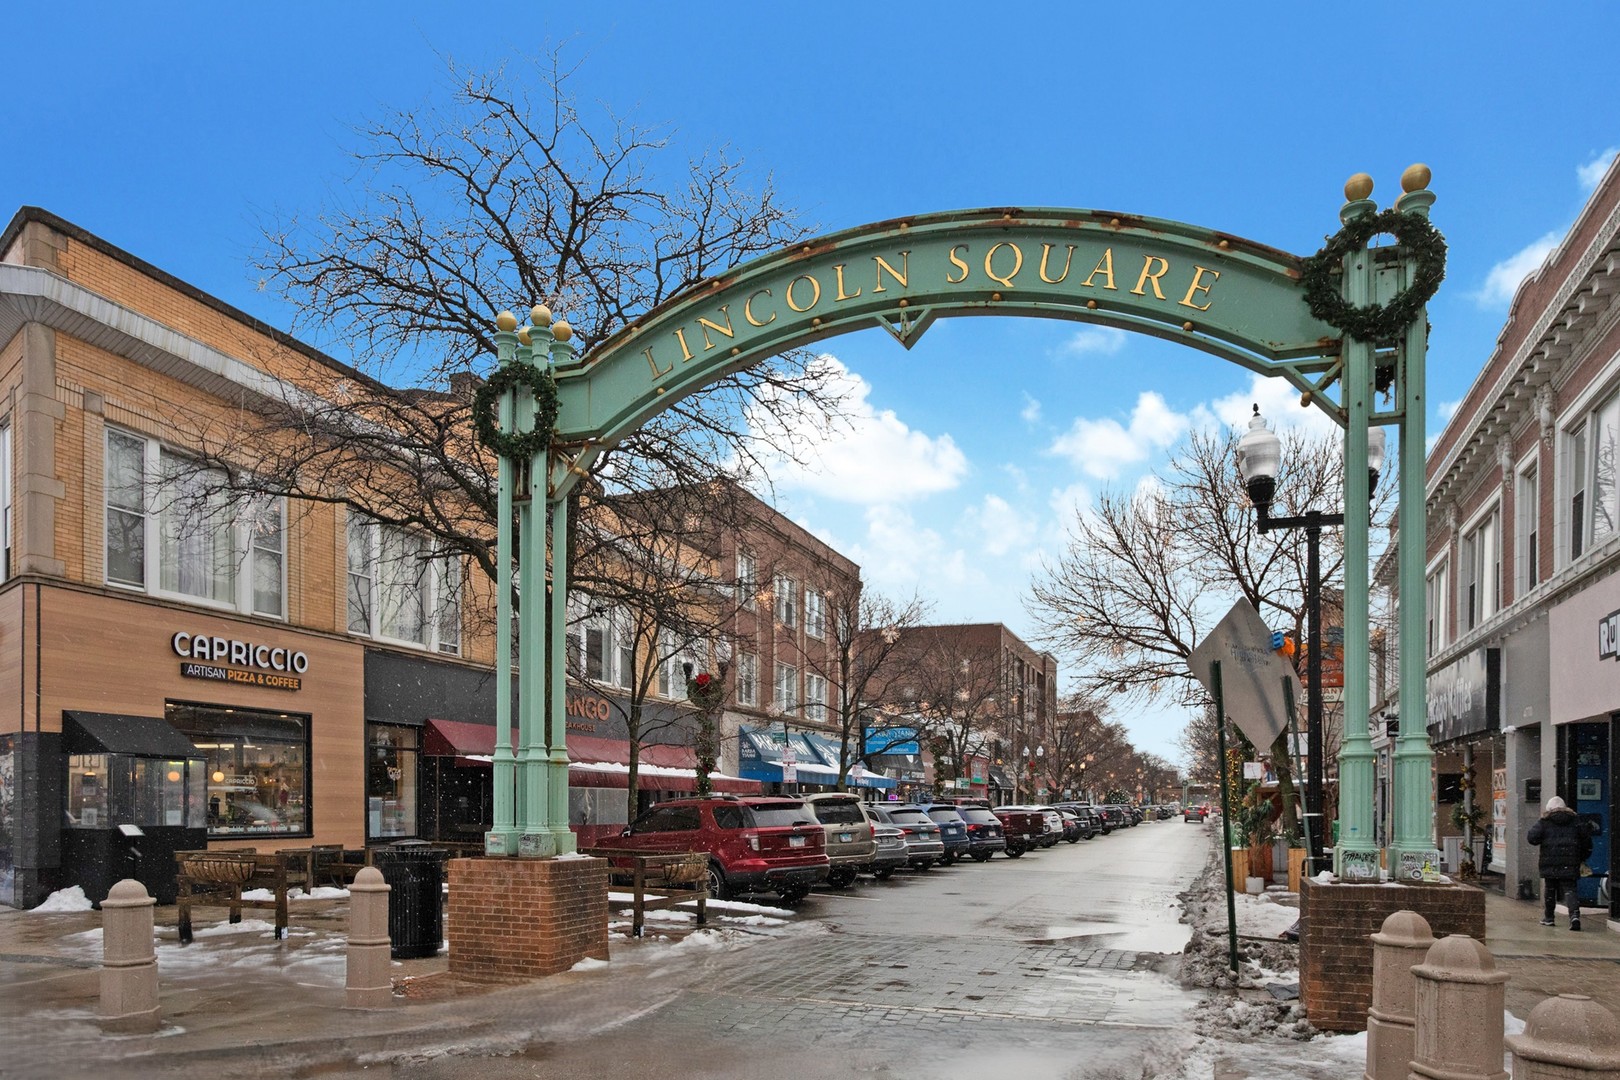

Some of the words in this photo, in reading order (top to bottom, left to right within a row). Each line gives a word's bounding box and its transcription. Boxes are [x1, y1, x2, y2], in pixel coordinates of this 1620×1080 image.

[642, 250, 911, 382] LINCOLN
[945, 241, 1221, 312] SQUARE
[171, 631, 309, 674] CAPRICCIO
[187, 664, 226, 680] ARTISAN
[227, 669, 256, 683] PIZZA
[257, 674, 264, 684] &
[265, 675, 299, 689] COFFEE
